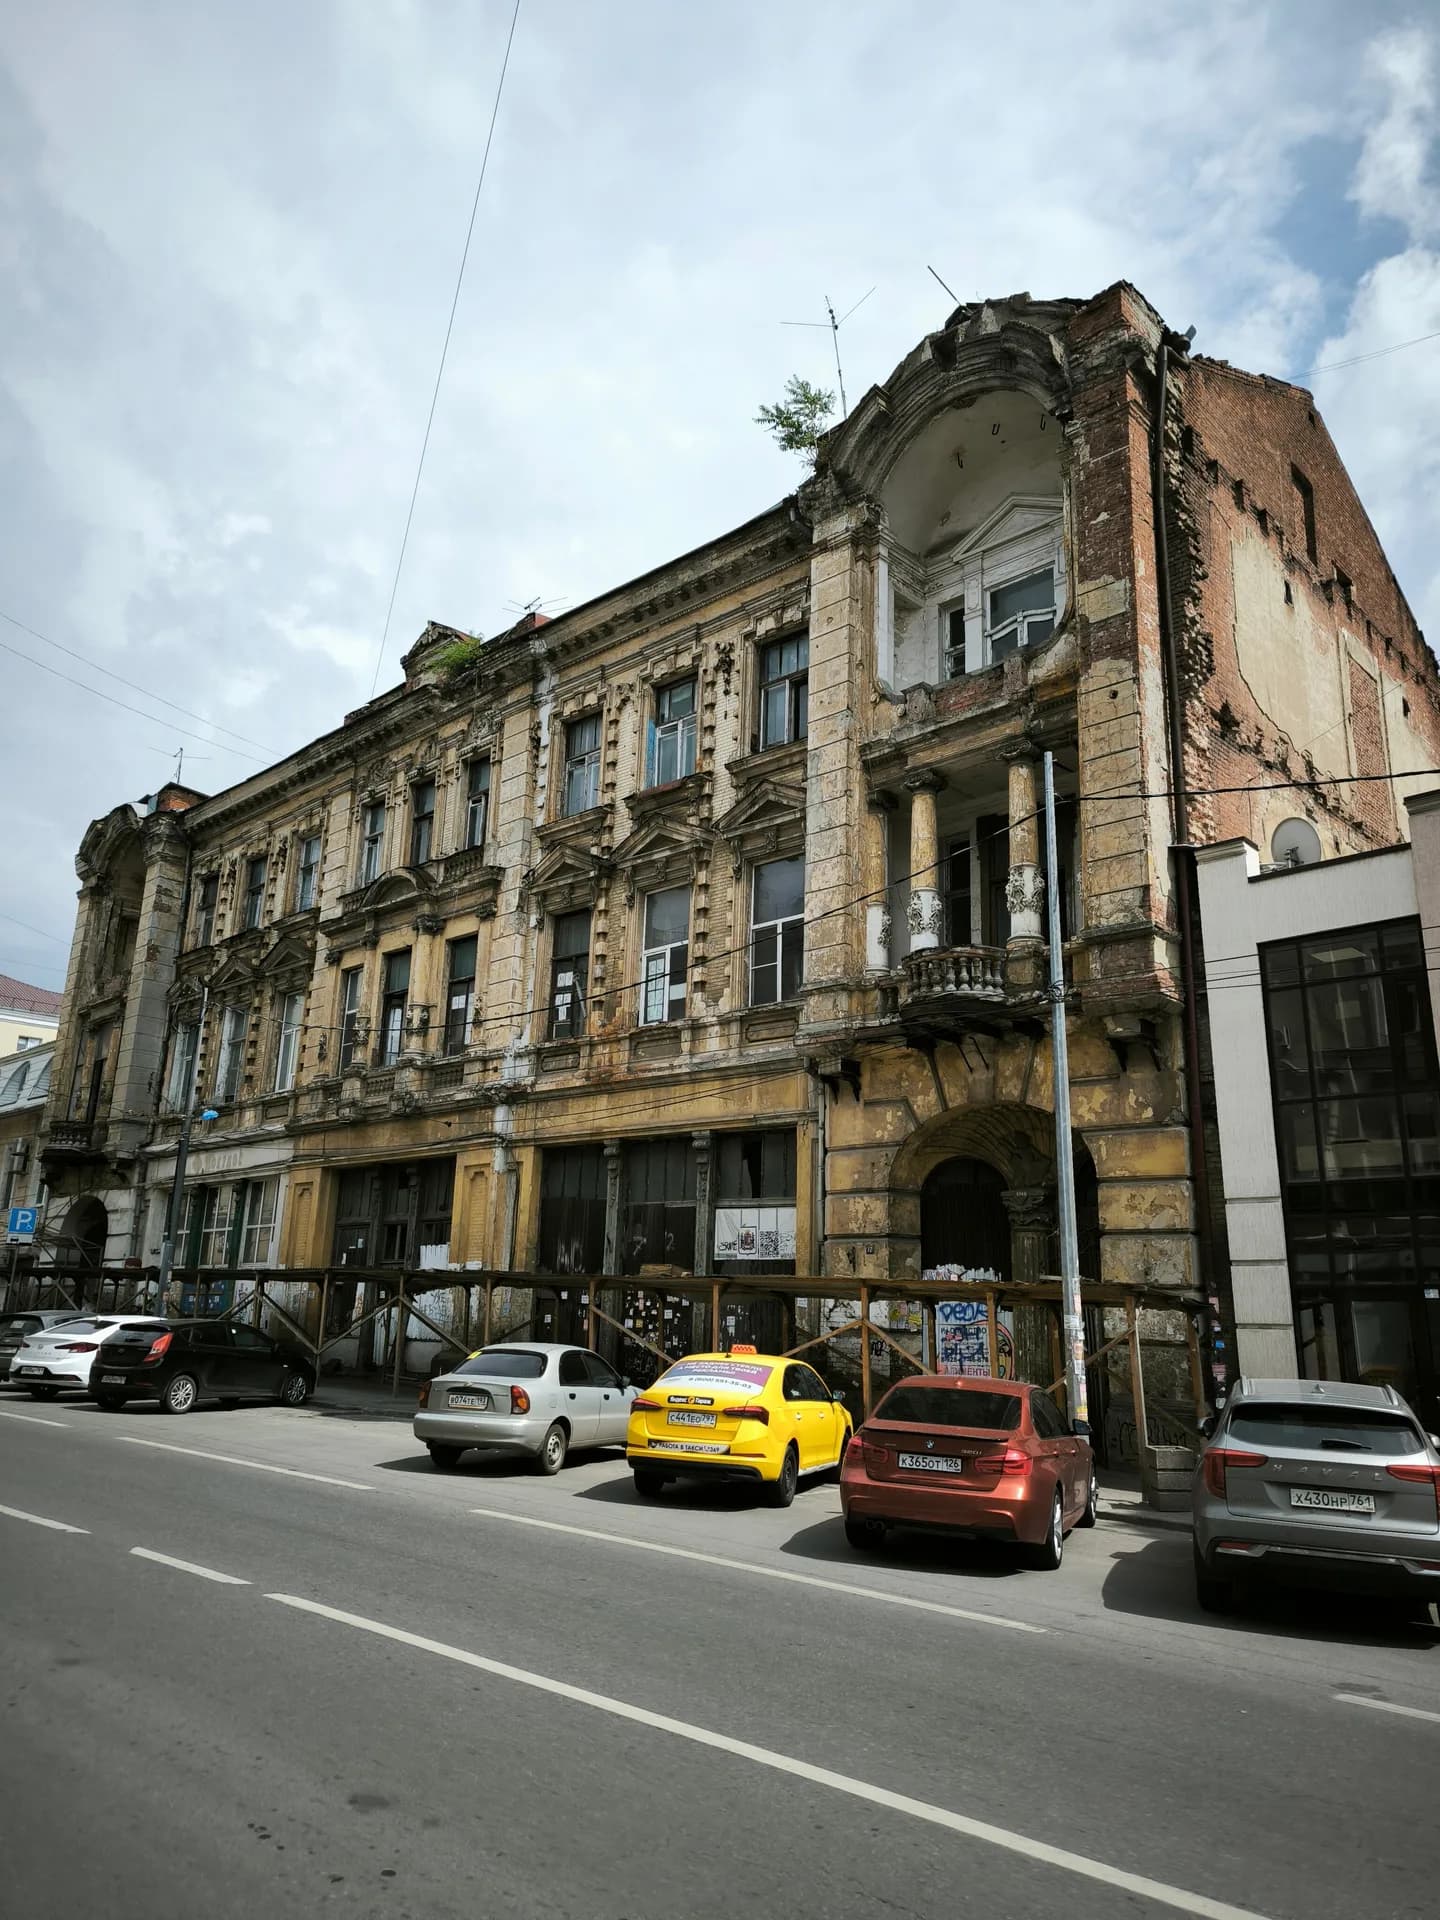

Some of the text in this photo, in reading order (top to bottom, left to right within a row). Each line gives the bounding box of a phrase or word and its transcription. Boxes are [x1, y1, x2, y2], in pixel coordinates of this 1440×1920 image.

[16, 1210, 32, 1230] P
[901, 1456, 960, 1469] К365ОТ 126
[1272, 1464, 1383, 1480] HAVAL
[1295, 1491, 1371, 1507] Х430НР 761
